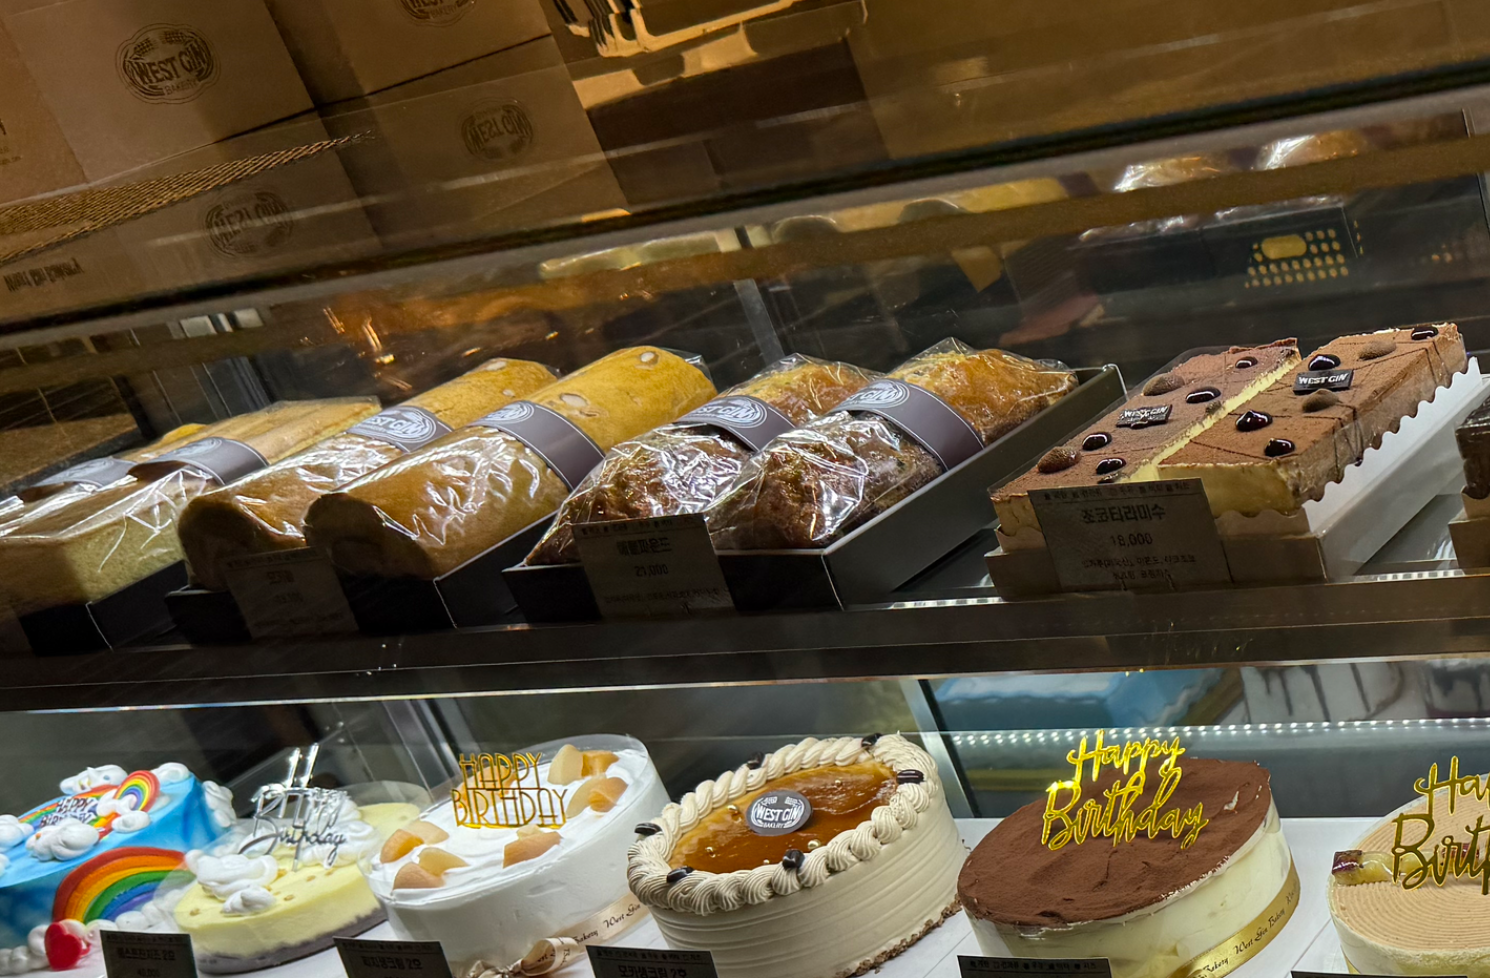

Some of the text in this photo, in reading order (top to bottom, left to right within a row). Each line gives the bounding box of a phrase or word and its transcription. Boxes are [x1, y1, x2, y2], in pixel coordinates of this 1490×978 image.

[128, 38, 210, 86] WEST GIN
[1298, 373, 1350, 385] WEST GIN
[1081, 503, 1167, 525] 초코티라미수
[1109, 532, 1154, 549] 18,000
[634, 563, 670, 577] 21,000
[459, 751, 543, 790] HAPPY
[1066, 728, 1186, 783] Happy
[451, 787, 569, 830] BIRTHDAY
[756, 803, 802, 822] WEST GIN
[1041, 766, 1210, 851] Birthday
